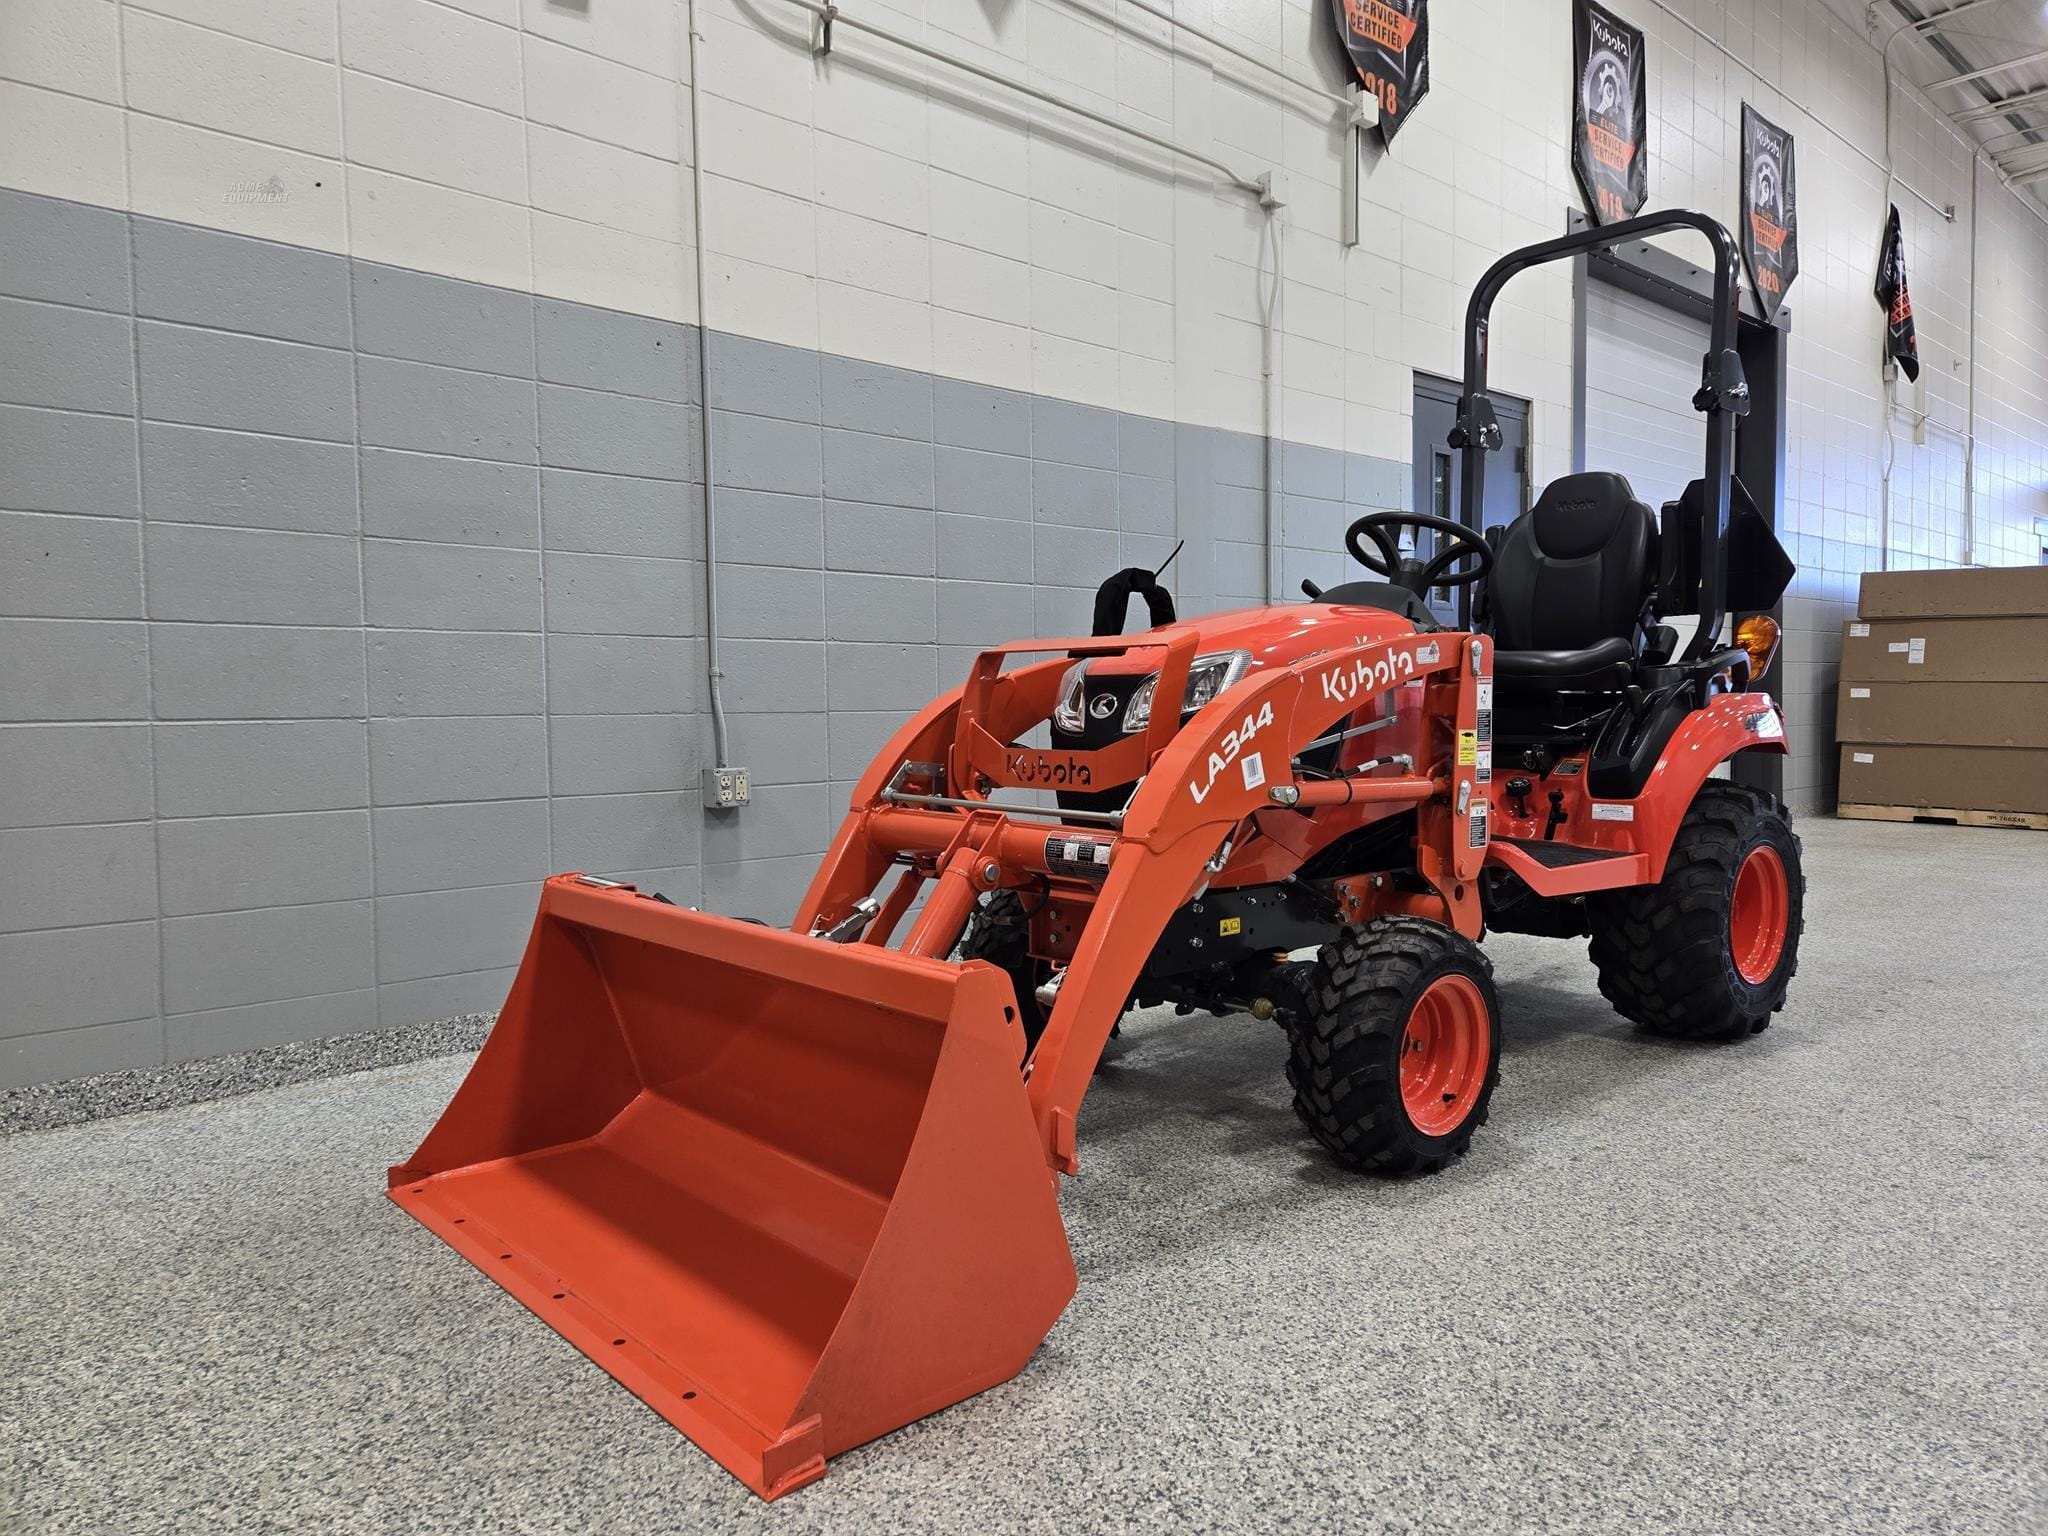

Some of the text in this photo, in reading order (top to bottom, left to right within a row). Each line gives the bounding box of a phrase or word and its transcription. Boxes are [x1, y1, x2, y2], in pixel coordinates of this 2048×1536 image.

[1355, 0, 1400, 29] SERVICE
[1350, 12, 1402, 49] CERTIFIED
[1593, 19, 1628, 57] Kubota
[1600, 117, 1618, 135] ELITE
[1592, 143, 1624, 169] CERTIFIED
[1594, 128, 1622, 155] SERVICE
[1756, 128, 1780, 158] Kubota
[1758, 218, 1777, 239] SERVICE
[1758, 264, 1780, 293] 2020
[1321, 647, 1414, 702] Kubota
[1189, 701, 1274, 804] LA344
[1007, 754, 1091, 785] Kubota
